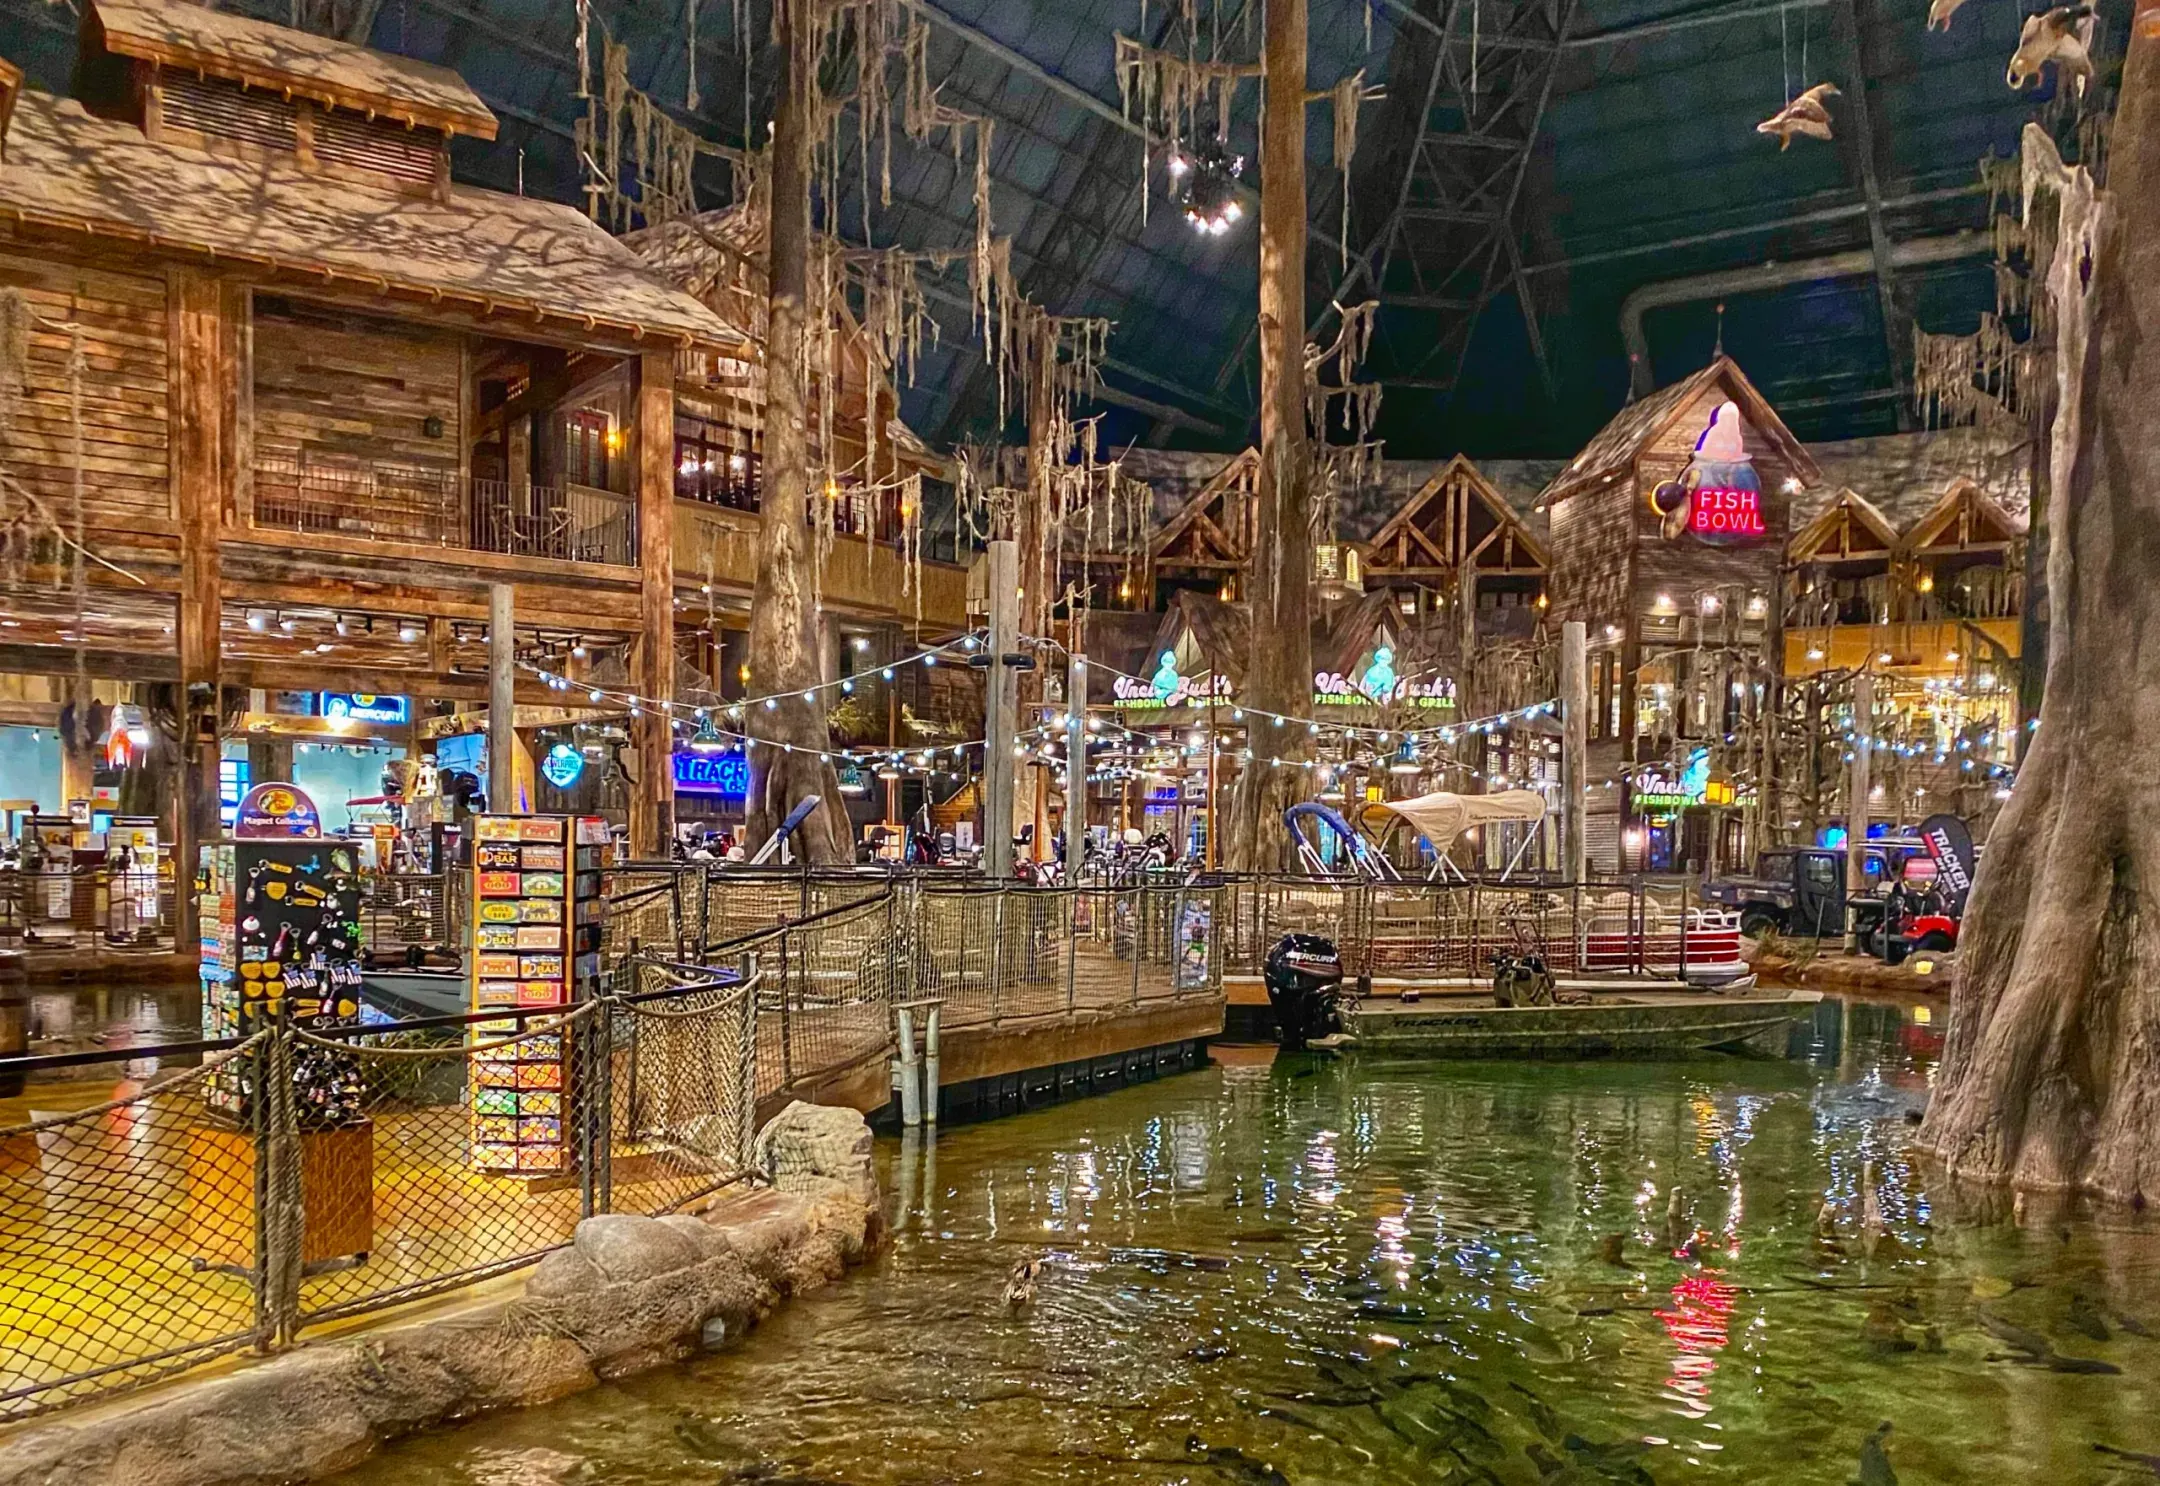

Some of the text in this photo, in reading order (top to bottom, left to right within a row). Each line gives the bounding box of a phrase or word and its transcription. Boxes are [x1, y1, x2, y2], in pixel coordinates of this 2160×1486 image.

[1701, 491, 1755, 510] FISH
[1696, 511, 1765, 530] BOWL
[1419, 698, 1456, 708] GRILL
[1635, 795, 1699, 806] FISHBOWL
[243, 817, 314, 826] Magnet Collection
[494, 854, 517, 864] BAR
[1931, 827, 1970, 890] TRACKER
[492, 936, 515, 945] BAR
[1286, 951, 1338, 963] MERCURY
[537, 965, 560, 974] BAR
